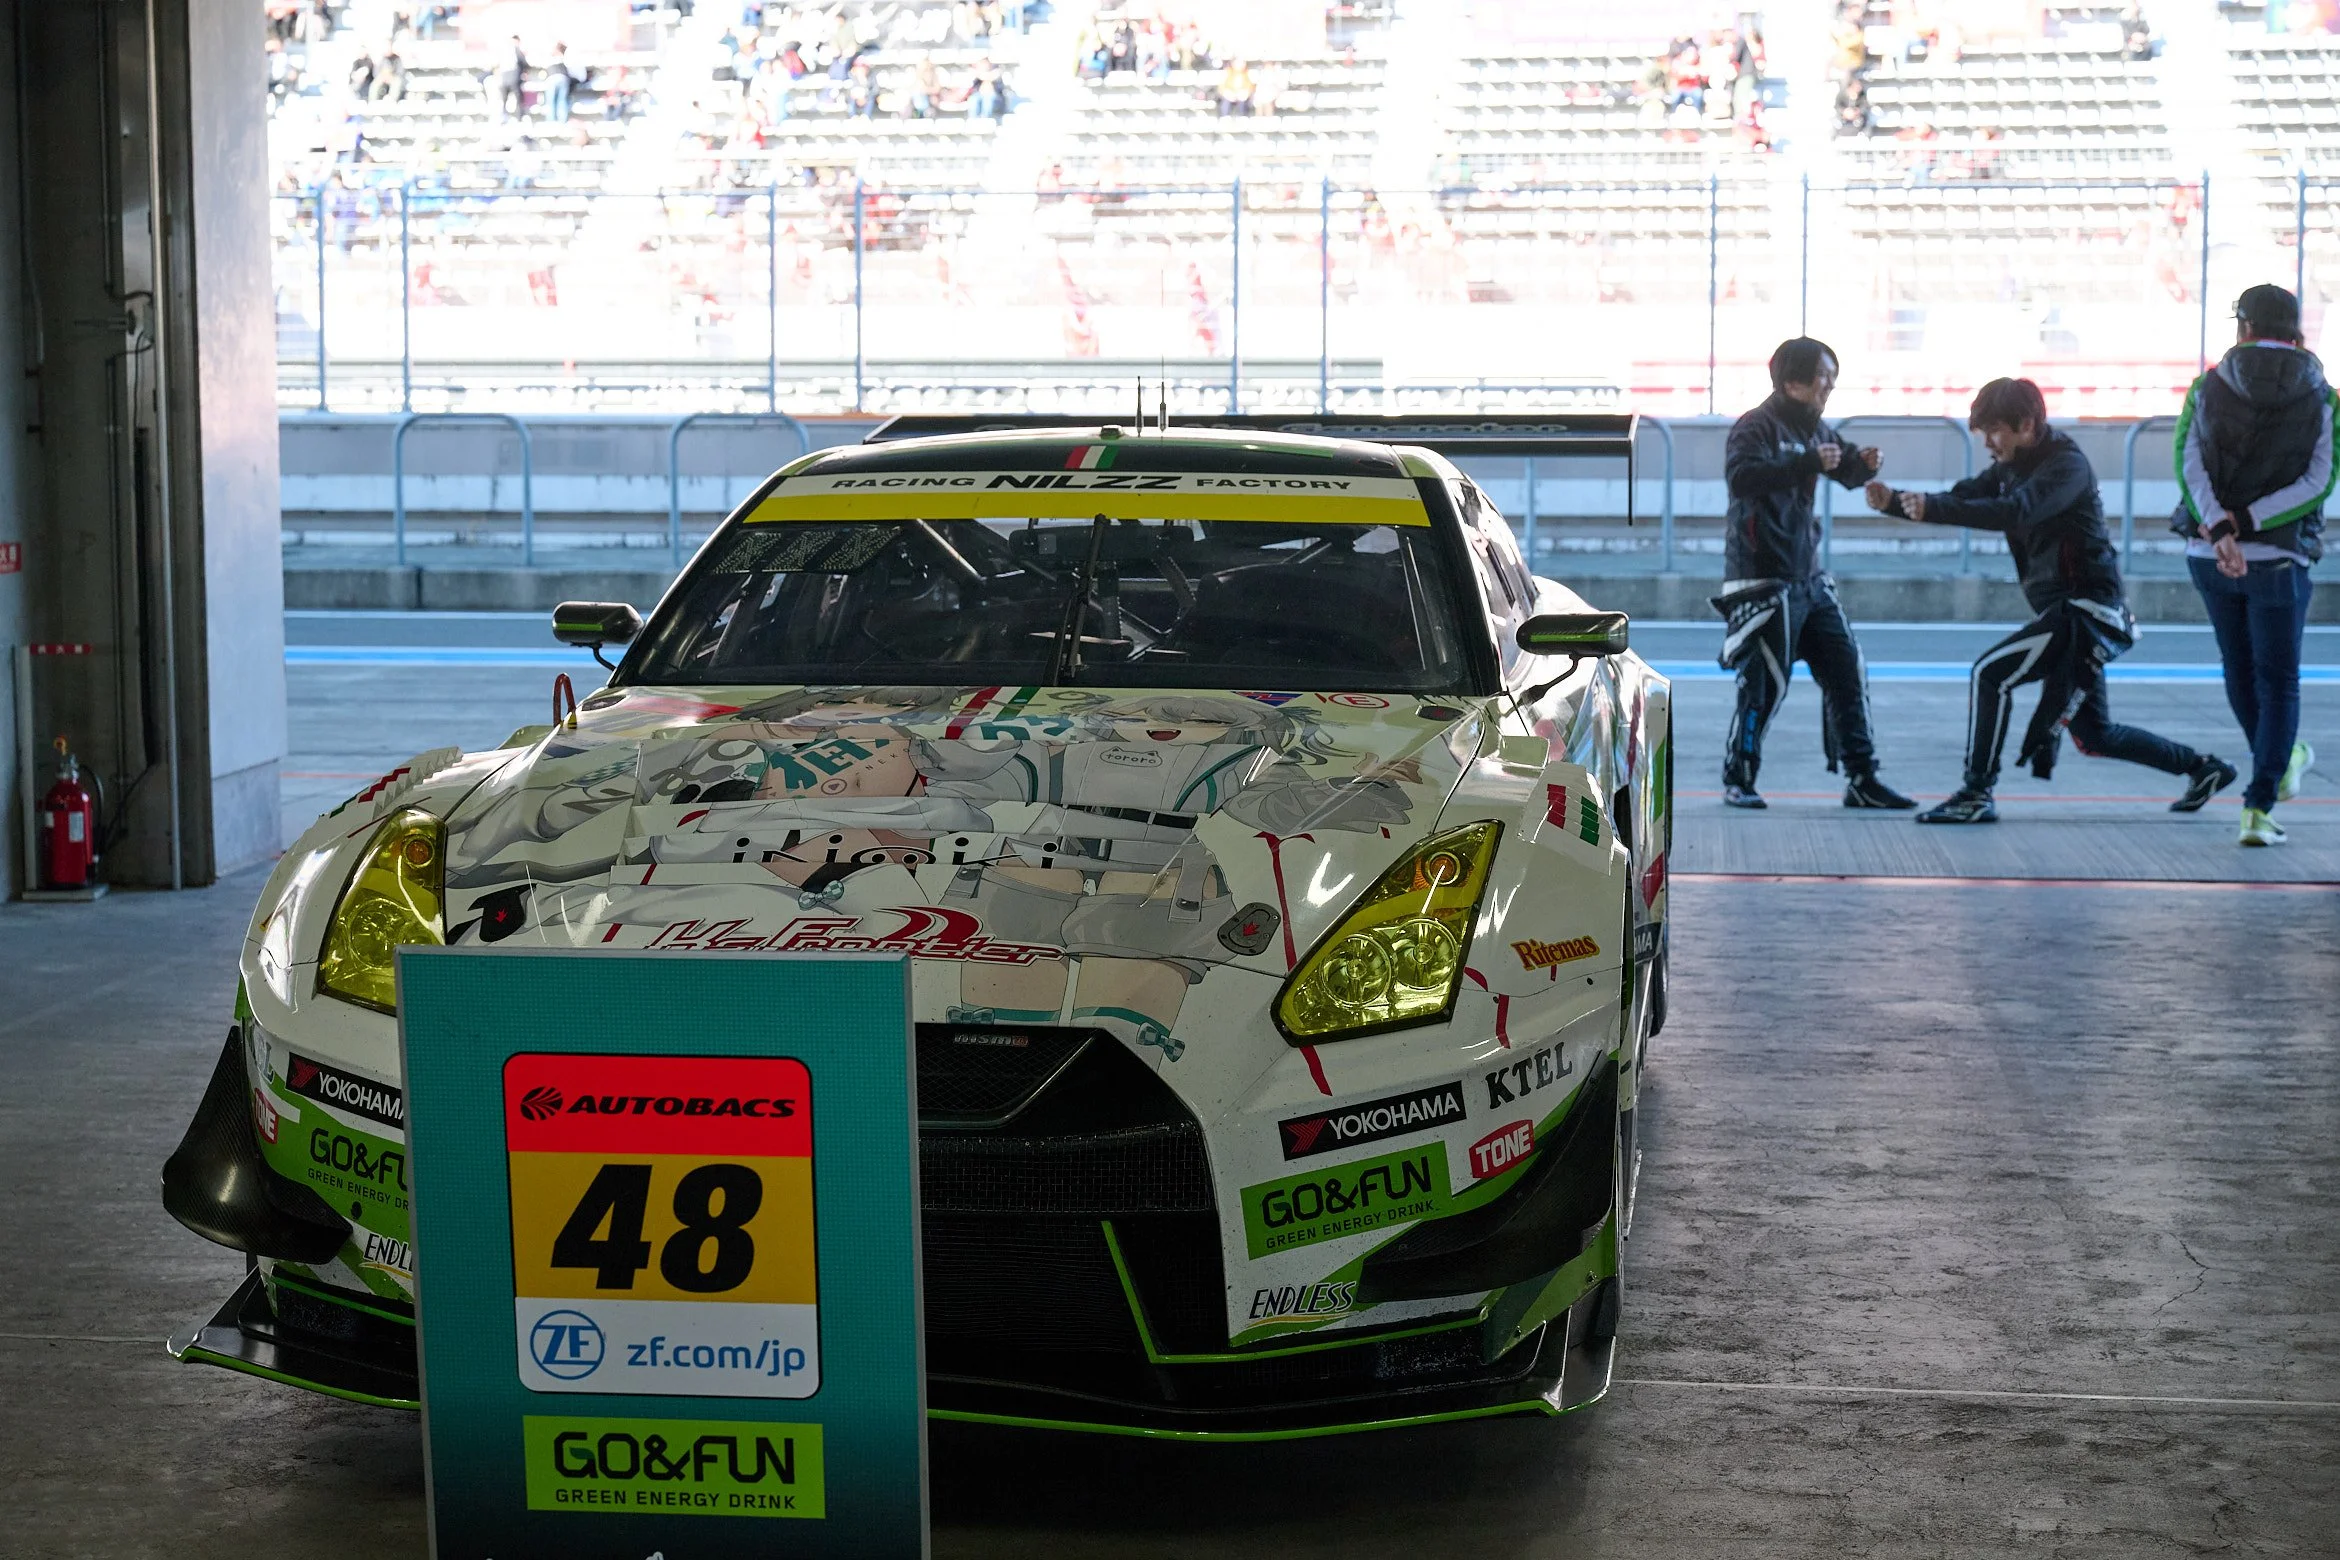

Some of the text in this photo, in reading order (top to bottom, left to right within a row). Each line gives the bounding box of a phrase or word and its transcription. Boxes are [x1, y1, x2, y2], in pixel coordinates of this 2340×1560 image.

[831, 474, 1352, 489] RACING NILZZ FACTORY
[1106, 753, 1156, 764] tororo
[1511, 935, 1600, 971] Ritemas
[1485, 1041, 1573, 1110] KTEL
[566, 1095, 796, 1118] AUTOBACS
[1328, 1091, 1461, 1140] YOKOHAMA
[1475, 1124, 1532, 1173] TONE
[307, 1167, 344, 1190] GREEN
[347, 1181, 392, 1206] ENERGY
[1261, 1155, 1432, 1229] GO&FUN
[550, 1163, 763, 1293] 48
[1266, 1199, 1434, 1249] GREEN ENERGY DRINK
[1248, 1281, 1356, 1320] ENDLESS
[538, 1324, 598, 1366] ZF
[626, 1336, 806, 1377] zf.com/jp
[553, 1431, 796, 1485] GO&FUN
[555, 1488, 796, 1510] GREEN ENERGY DRINK
